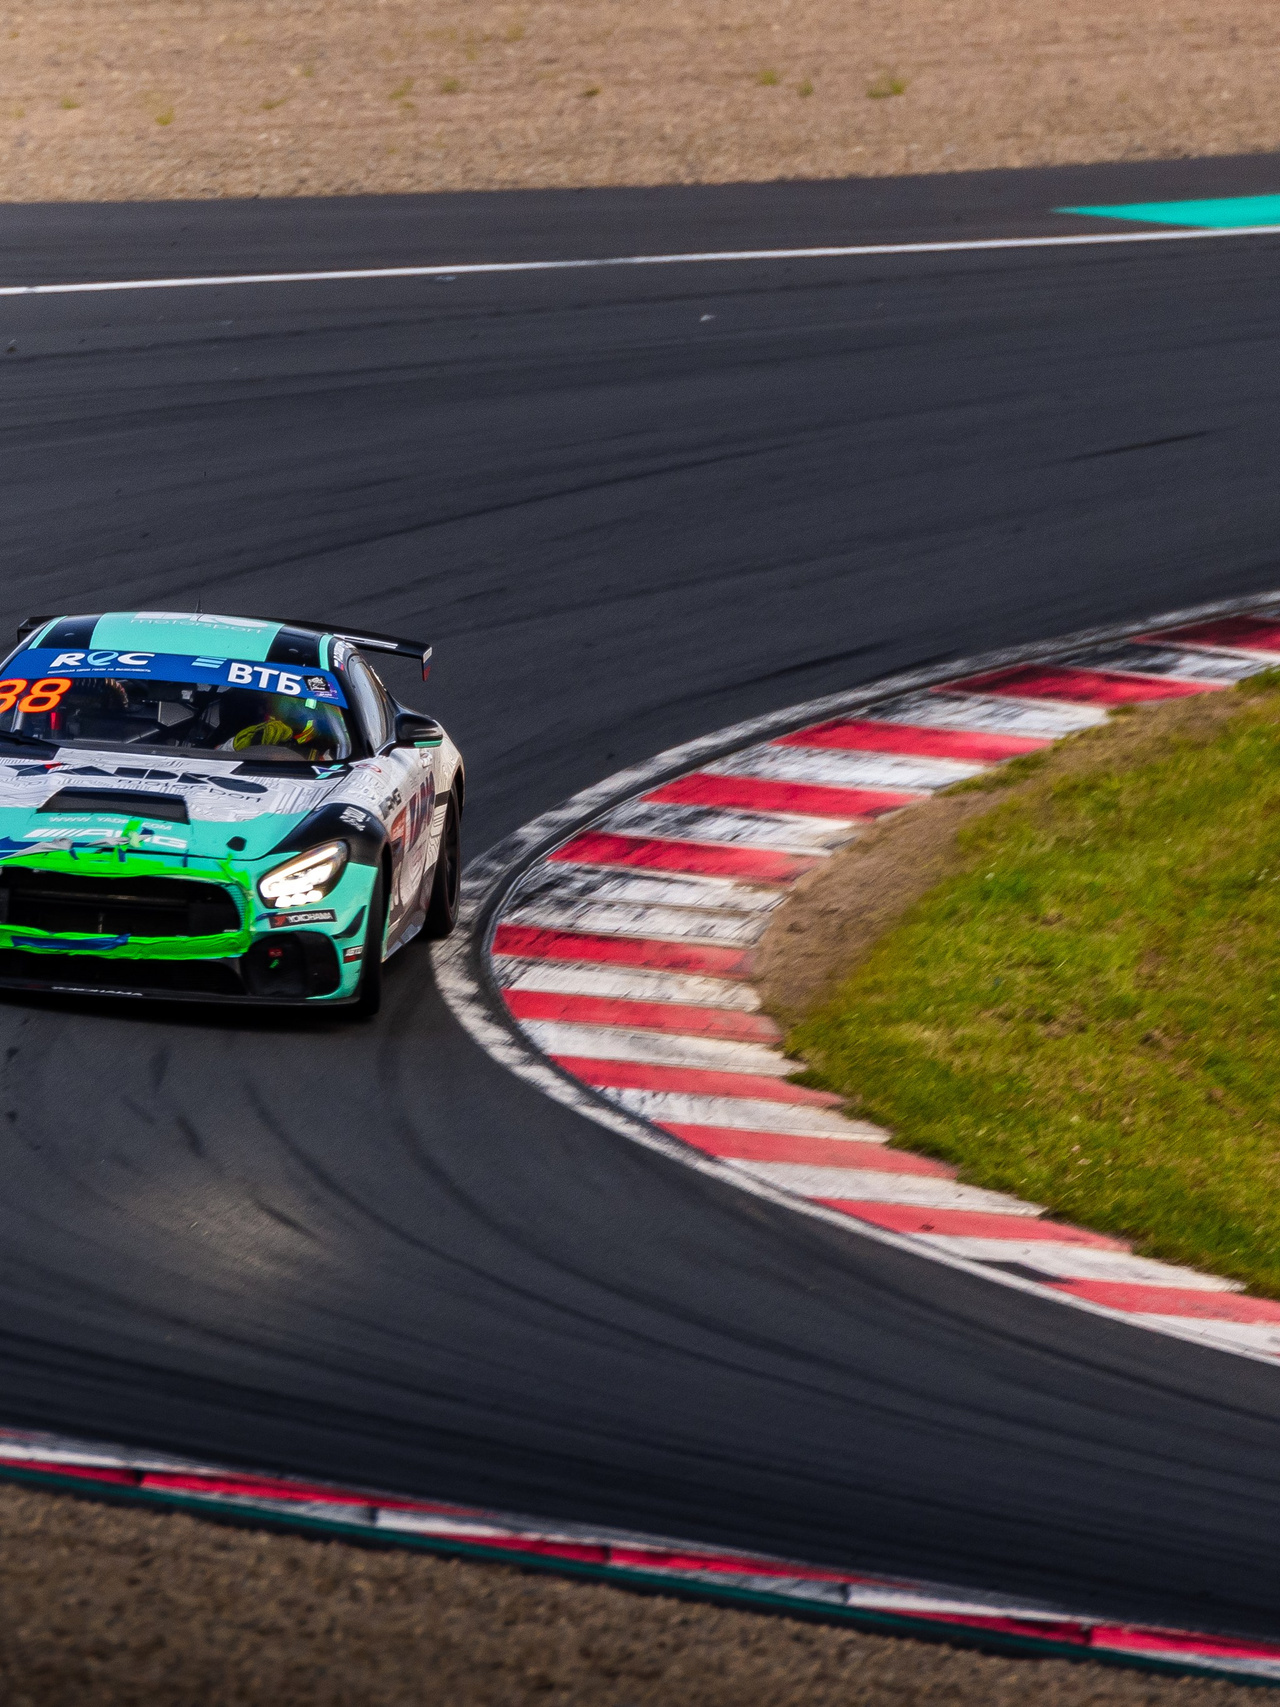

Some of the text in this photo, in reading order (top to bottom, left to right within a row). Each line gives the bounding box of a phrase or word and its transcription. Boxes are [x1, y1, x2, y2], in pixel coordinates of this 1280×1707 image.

[227, 662, 303, 695] ВТБ
[117, 778, 262, 802] motorsport
[286, 912, 334, 924] YOKOHAMA
